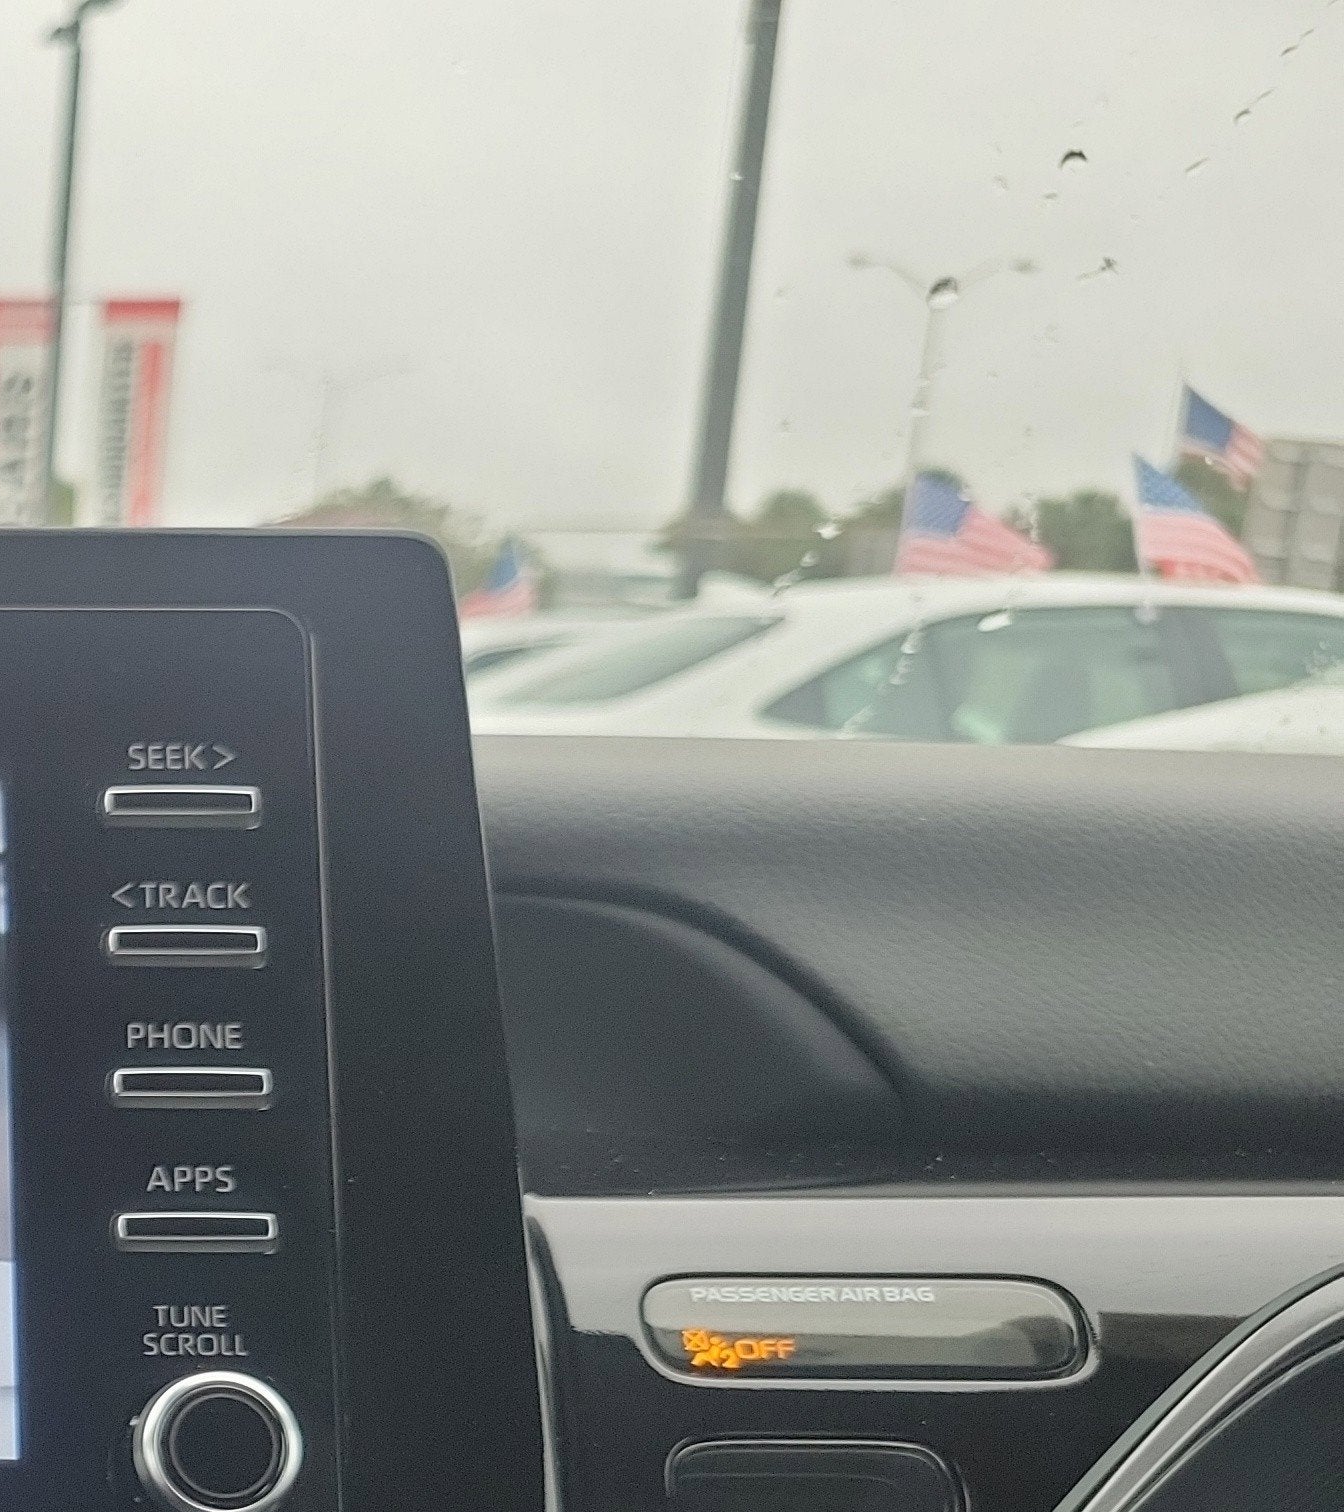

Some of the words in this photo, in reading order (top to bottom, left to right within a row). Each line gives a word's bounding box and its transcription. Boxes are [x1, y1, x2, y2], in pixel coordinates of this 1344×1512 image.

[126, 1022, 244, 1050] PHONE
[146, 1164, 238, 1193] APPS
[689, 1285, 836, 1304] PASSENGER
[839, 1285, 880, 1304] AIR
[882, 1286, 936, 1304] BAG
[152, 1304, 231, 1329] TUNE
[142, 1332, 248, 1358] SCROLL
[735, 1337, 796, 1361] OFF
